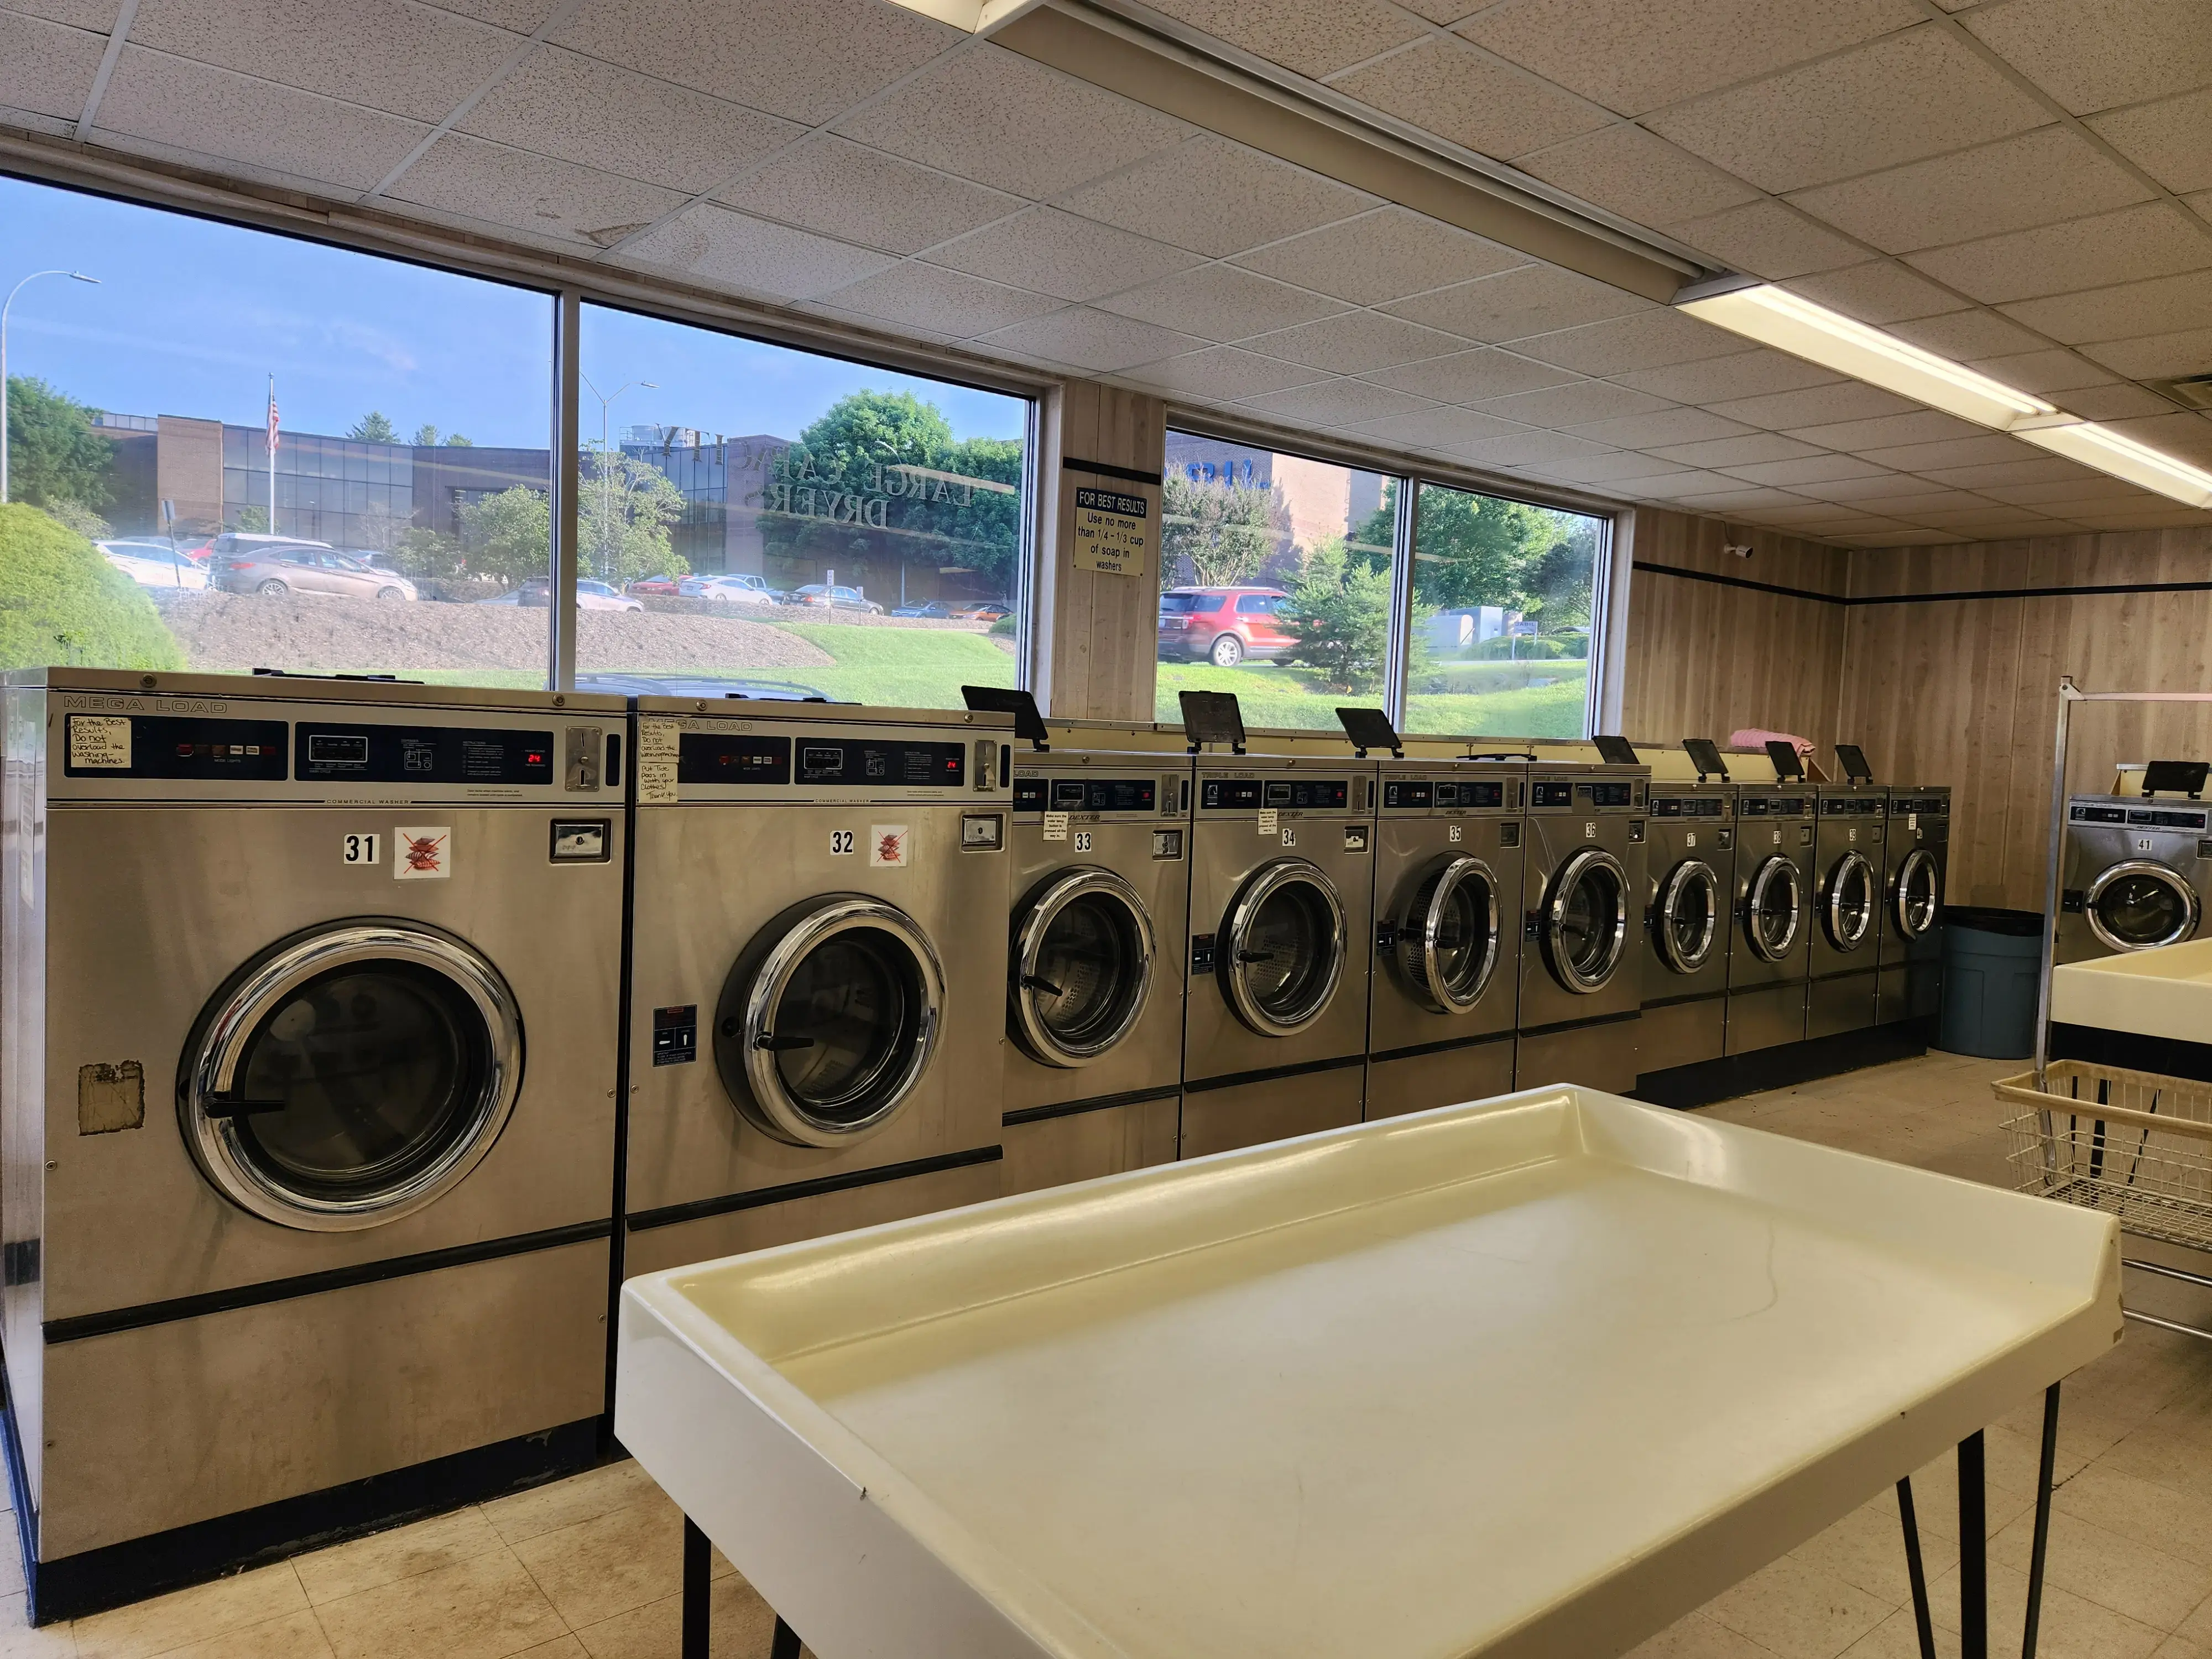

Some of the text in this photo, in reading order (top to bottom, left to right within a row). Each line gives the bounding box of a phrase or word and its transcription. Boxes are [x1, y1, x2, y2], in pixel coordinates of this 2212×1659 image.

[1079, 491, 1145, 514] FOR BEST RESULTS
[1087, 512, 1136, 530] Use no more
[1078, 526, 1094, 538] than
[1098, 528, 1108, 541] 1/4
[1117, 531, 1126, 544] 1/3
[1130, 536, 1144, 547] cup
[1091, 544, 1130, 559] of soap in
[1096, 560, 1121, 572] washers
[64, 695, 227, 714] MEGA LOAD
[72, 718, 85, 726] For
[103, 718, 126, 726] Best
[707, 721, 752, 732] LOAD
[72, 733, 86, 742] Do
[528, 754, 540, 763] 24
[1451, 826, 1460, 840] 35
[1587, 823, 1595, 836] 36
[832, 831, 853, 853] 32
[1076, 833, 1091, 851] 33
[1284, 830, 1295, 844] 34
[1687, 833, 1695, 846] 37
[346, 836, 374, 862] 31
[2138, 839, 2150, 850] 41
